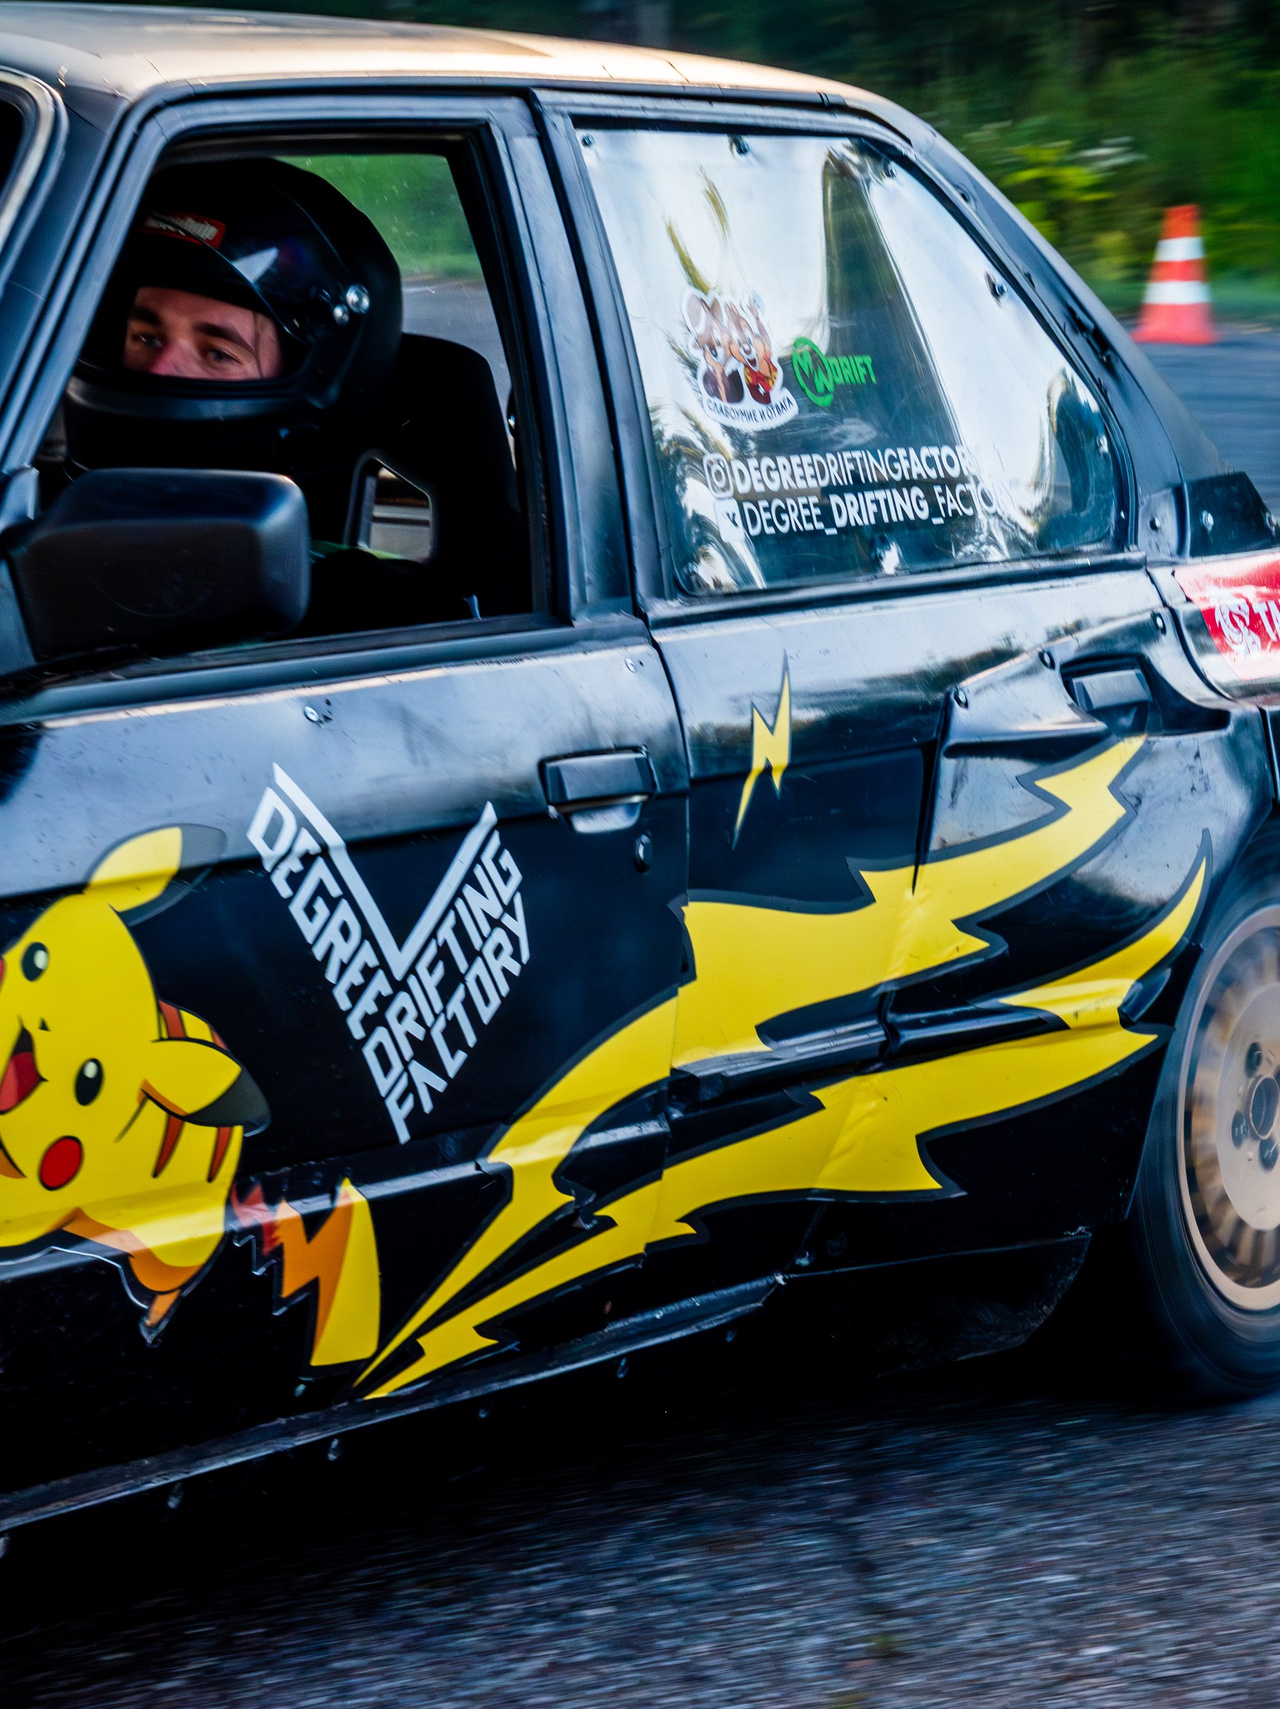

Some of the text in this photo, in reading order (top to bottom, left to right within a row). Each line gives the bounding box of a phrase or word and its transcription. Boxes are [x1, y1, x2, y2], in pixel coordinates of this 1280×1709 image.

[827, 354, 877, 385] DRIFT
[246, 786, 393, 1040] DEGREE
[361, 830, 523, 1098] DRIFTING
[384, 892, 530, 1145] FACTORY
